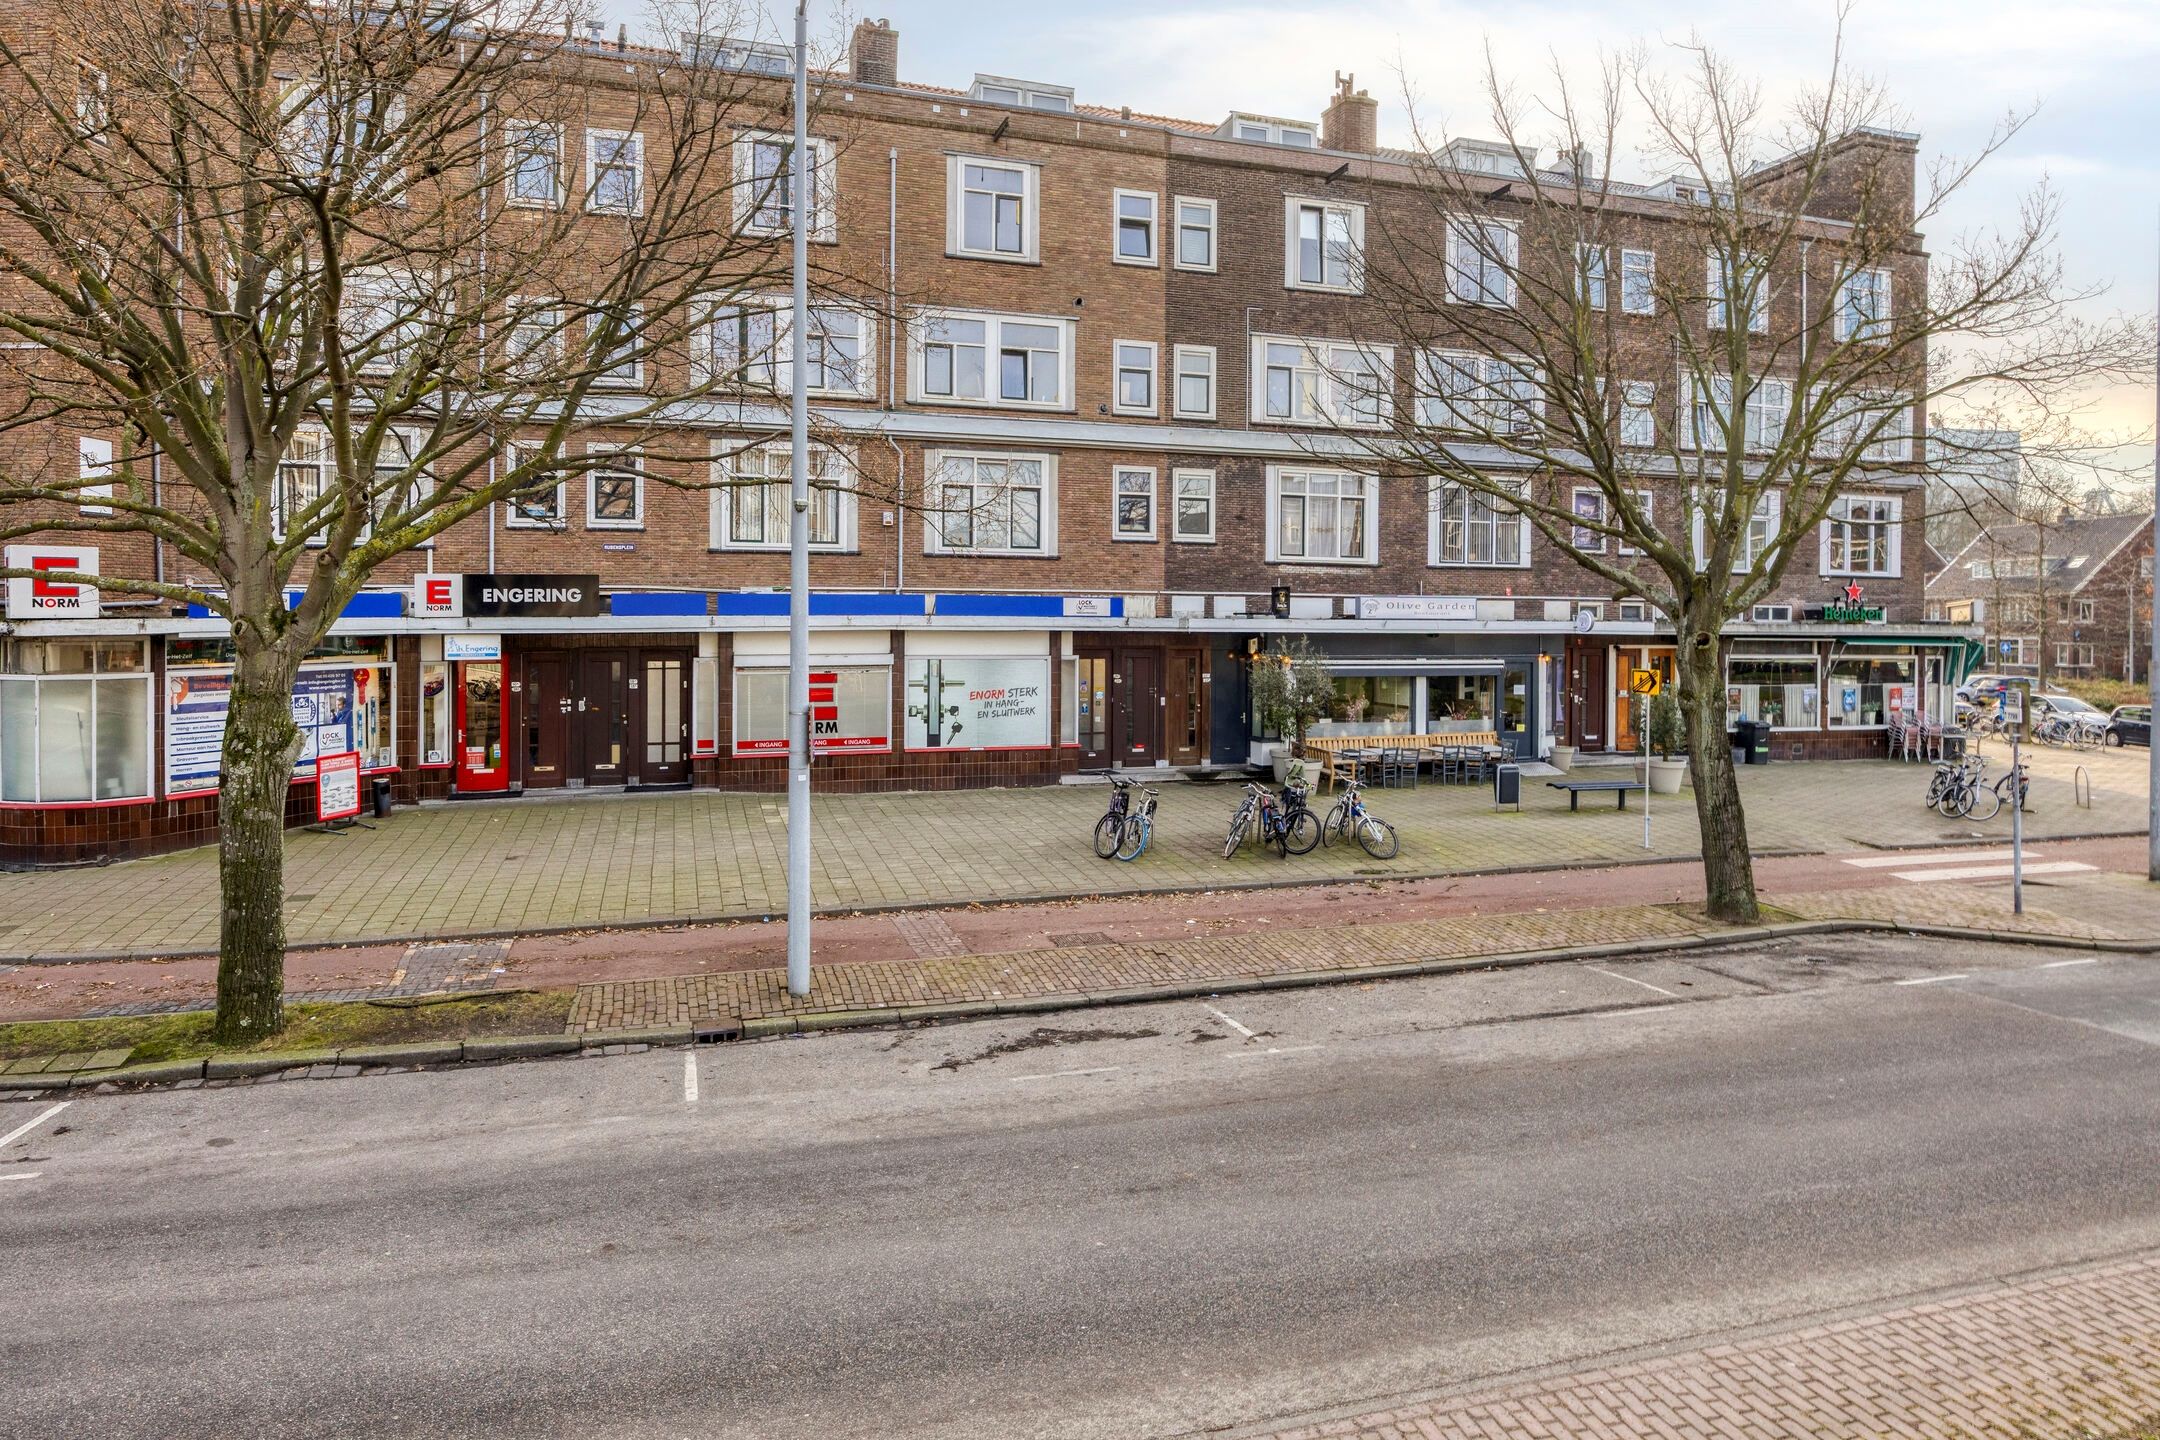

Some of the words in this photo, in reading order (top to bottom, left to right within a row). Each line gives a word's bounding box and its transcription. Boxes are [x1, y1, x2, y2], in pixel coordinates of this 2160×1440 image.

[426, 580, 452, 605] E
[482, 588, 582, 603] ENGERING
[32, 598, 80, 608] NORM
[1386, 601, 1421, 610] Olive
[1427, 601, 1475, 610] Garden
[1824, 606, 1883, 620] Heineken
[465, 643, 499, 653] Engering
[969, 689, 1005, 700] ENORM
[1007, 686, 1039, 698] STERK
[984, 700, 993, 709] IN
[995, 699, 1025, 708] HANG-
[977, 710, 989, 719] EN
[991, 706, 1036, 718] SLUITWERK
[815, 721, 839, 734] RM
[322, 732, 339, 740] LOCK
